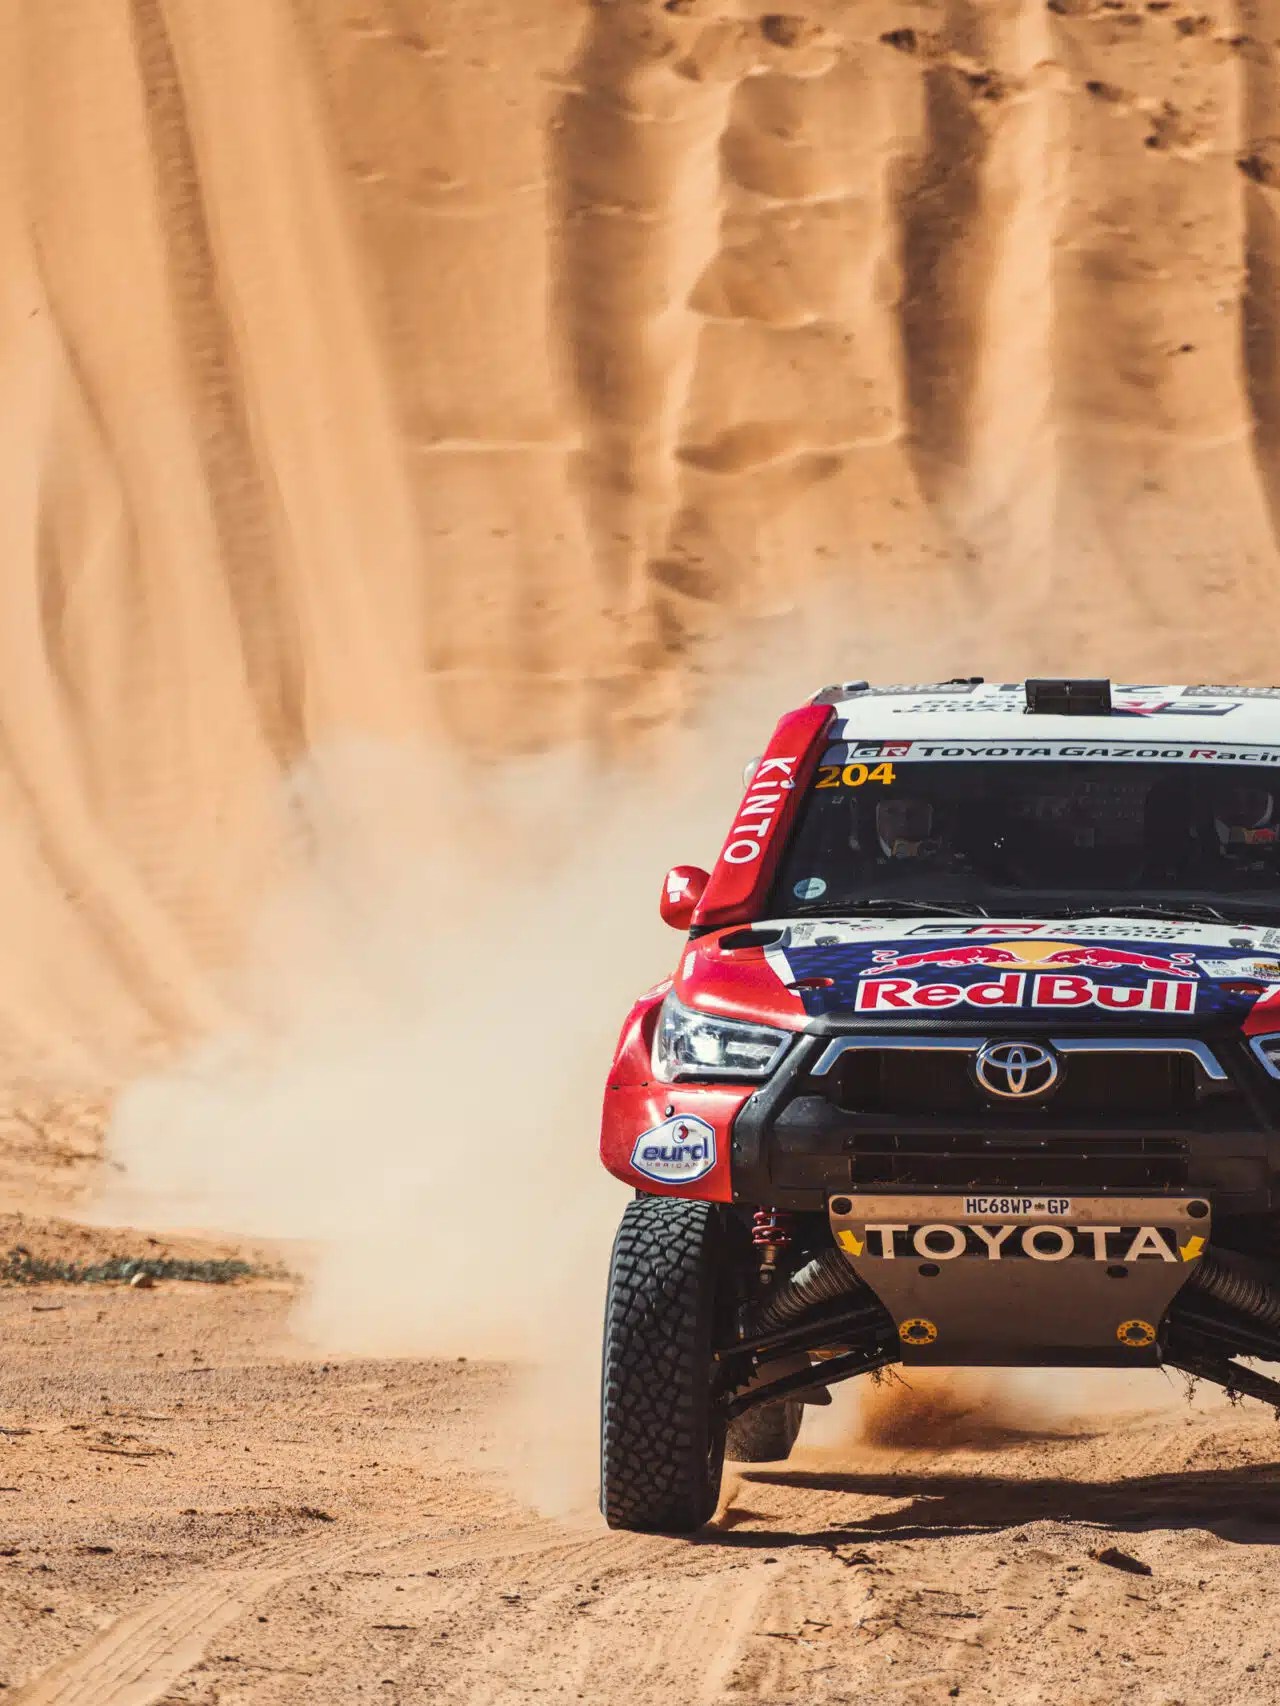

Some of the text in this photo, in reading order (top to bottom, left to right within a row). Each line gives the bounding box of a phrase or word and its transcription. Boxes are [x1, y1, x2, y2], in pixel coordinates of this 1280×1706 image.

[853, 746, 908, 757] GR
[917, 747, 1052, 757] TOYOTA
[1058, 747, 1184, 758] GAZOO
[815, 763, 897, 788] 204
[859, 973, 1195, 1012] Red Bull
[642, 1136, 709, 1161] eurol
[966, 1199, 1069, 1214] HC68WP GP
[864, 1224, 1178, 1263] TOYOTA
